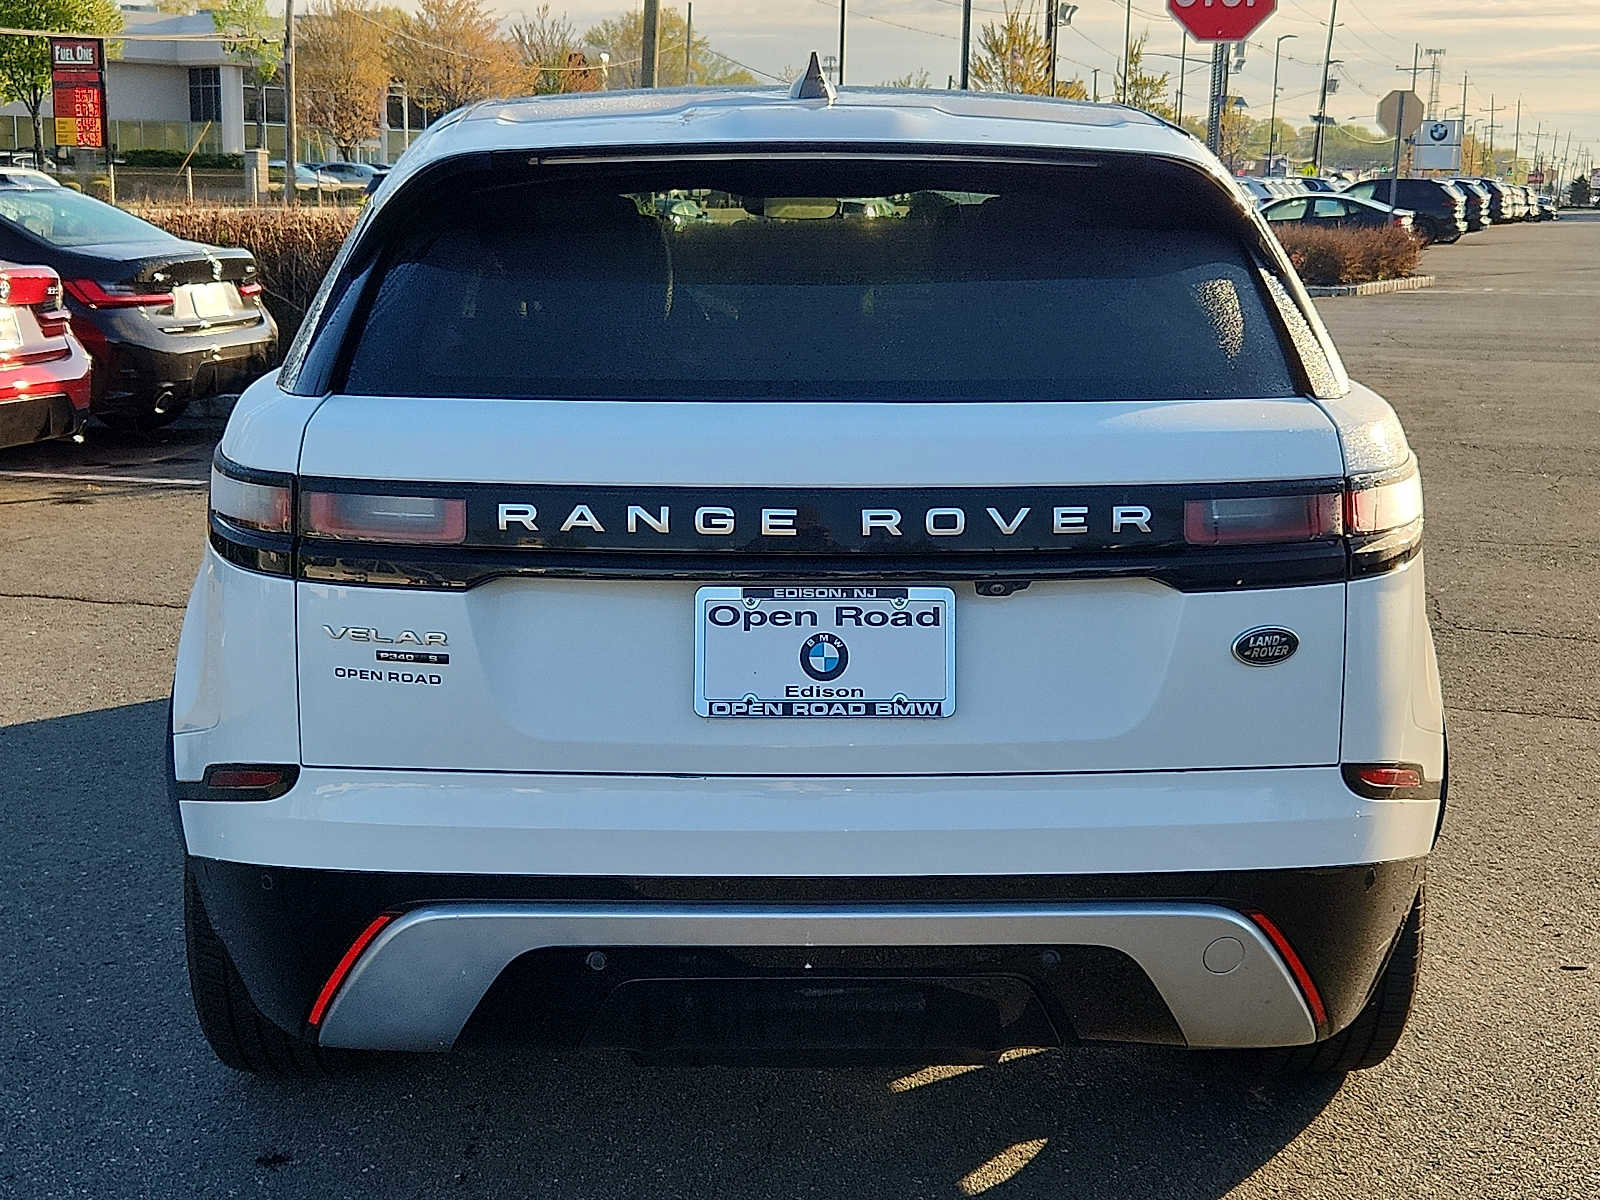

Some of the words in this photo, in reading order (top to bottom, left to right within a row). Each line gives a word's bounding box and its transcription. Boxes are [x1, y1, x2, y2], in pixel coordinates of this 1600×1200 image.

[498, 503, 798, 535] RANGE
[862, 505, 1153, 536] ROVER
[773, 588, 848, 599] EDISON,
[853, 588, 877, 598] NJ
[708, 605, 818, 632] Open
[835, 605, 941, 627] Road
[322, 624, 448, 647] VELAR
[807, 634, 844, 648] BMW
[379, 652, 415, 661] P340
[335, 667, 383, 681] OPEN
[388, 671, 442, 685] ROAD
[785, 685, 865, 698] Edison
[711, 702, 783, 716] OPEN
[792, 702, 866, 716] ROAD
[875, 702, 940, 716] BMW
